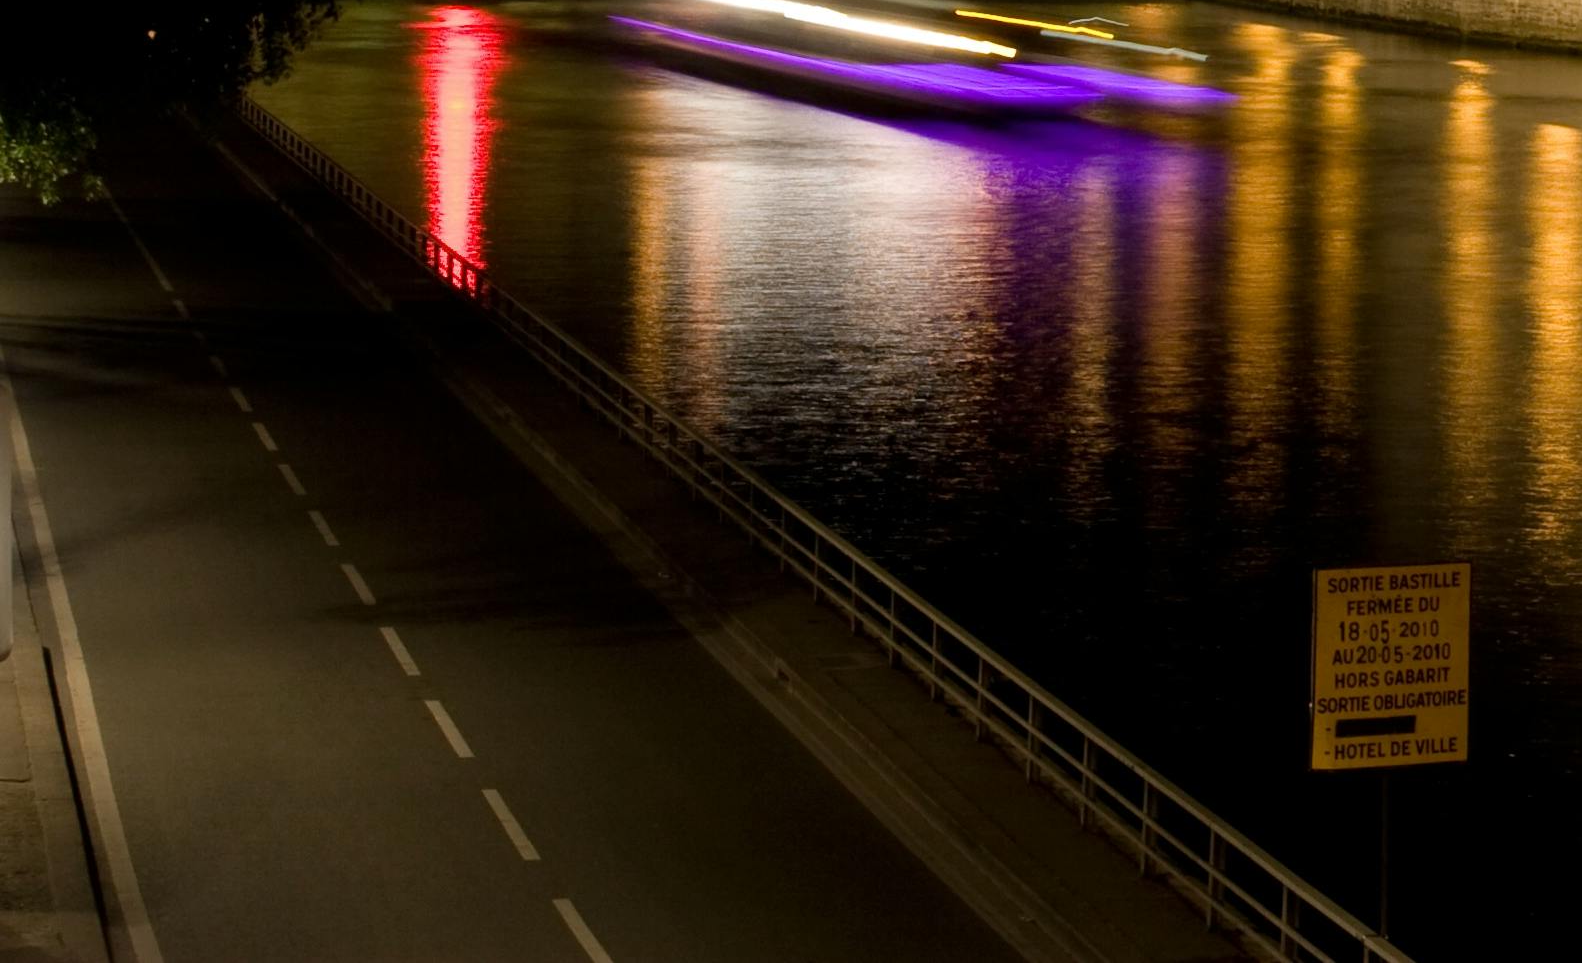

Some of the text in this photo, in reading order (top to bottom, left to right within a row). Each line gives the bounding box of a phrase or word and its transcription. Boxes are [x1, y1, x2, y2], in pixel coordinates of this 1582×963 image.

[1328, 572, 1461, 593] SORTIE BASTILLE
[1347, 594, 1440, 616] FERMÉE DU
[1333, 649, 1354, 666] AU
[1335, 667, 1451, 689] HORS GABARIT
[1317, 689, 1466, 714] SORTIE OBLIGATOIRE
[1391, 739, 1410, 757] DE
[1416, 736, 1458, 755] VILLE
